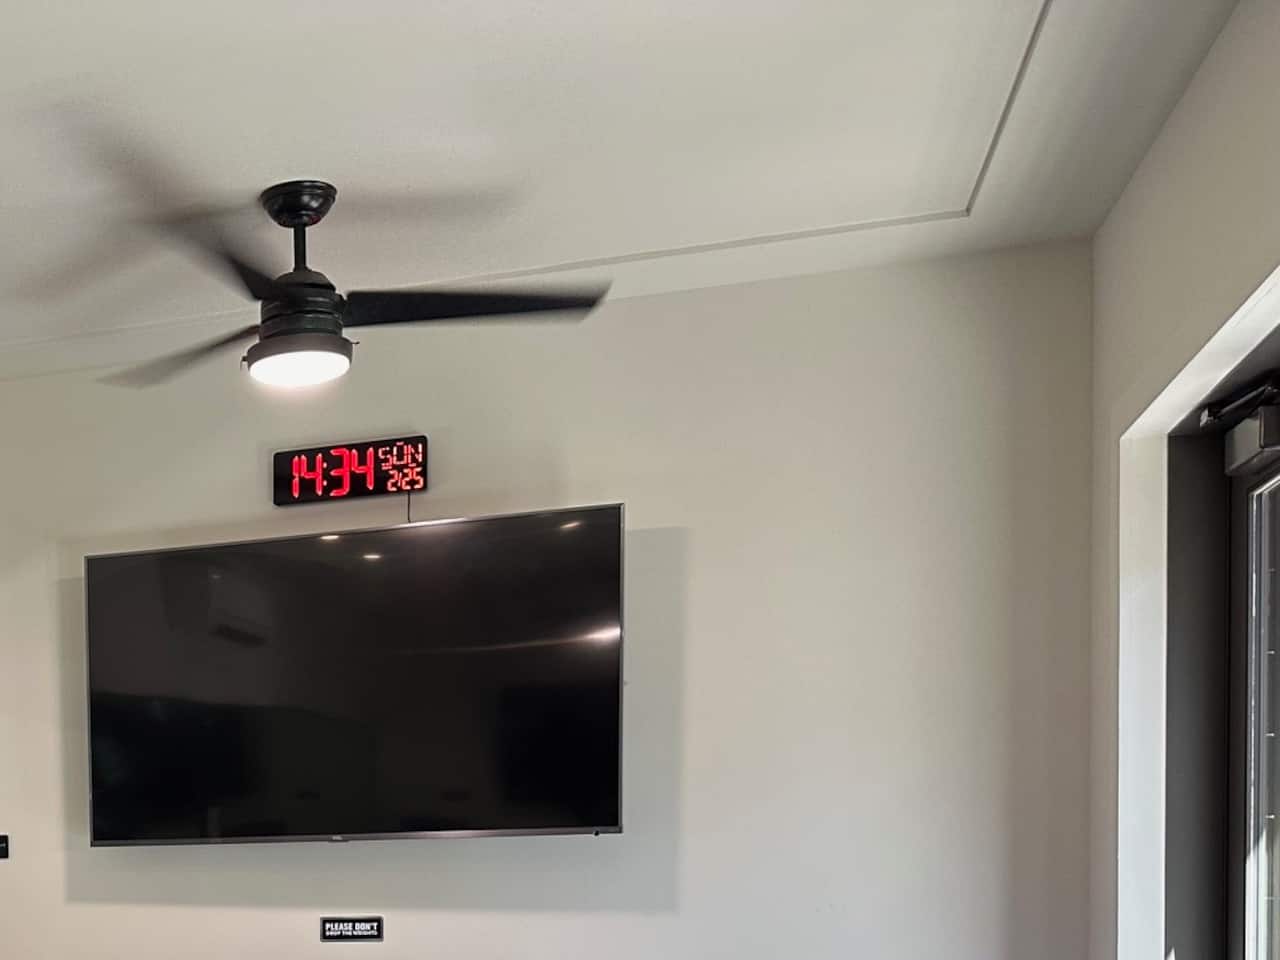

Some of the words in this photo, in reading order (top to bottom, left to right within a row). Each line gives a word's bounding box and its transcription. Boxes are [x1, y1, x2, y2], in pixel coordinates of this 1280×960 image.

[378, 441, 423, 470] SUN
[291, 447, 375, 498] 14:34
[325, 922, 353, 931] PLEASE
